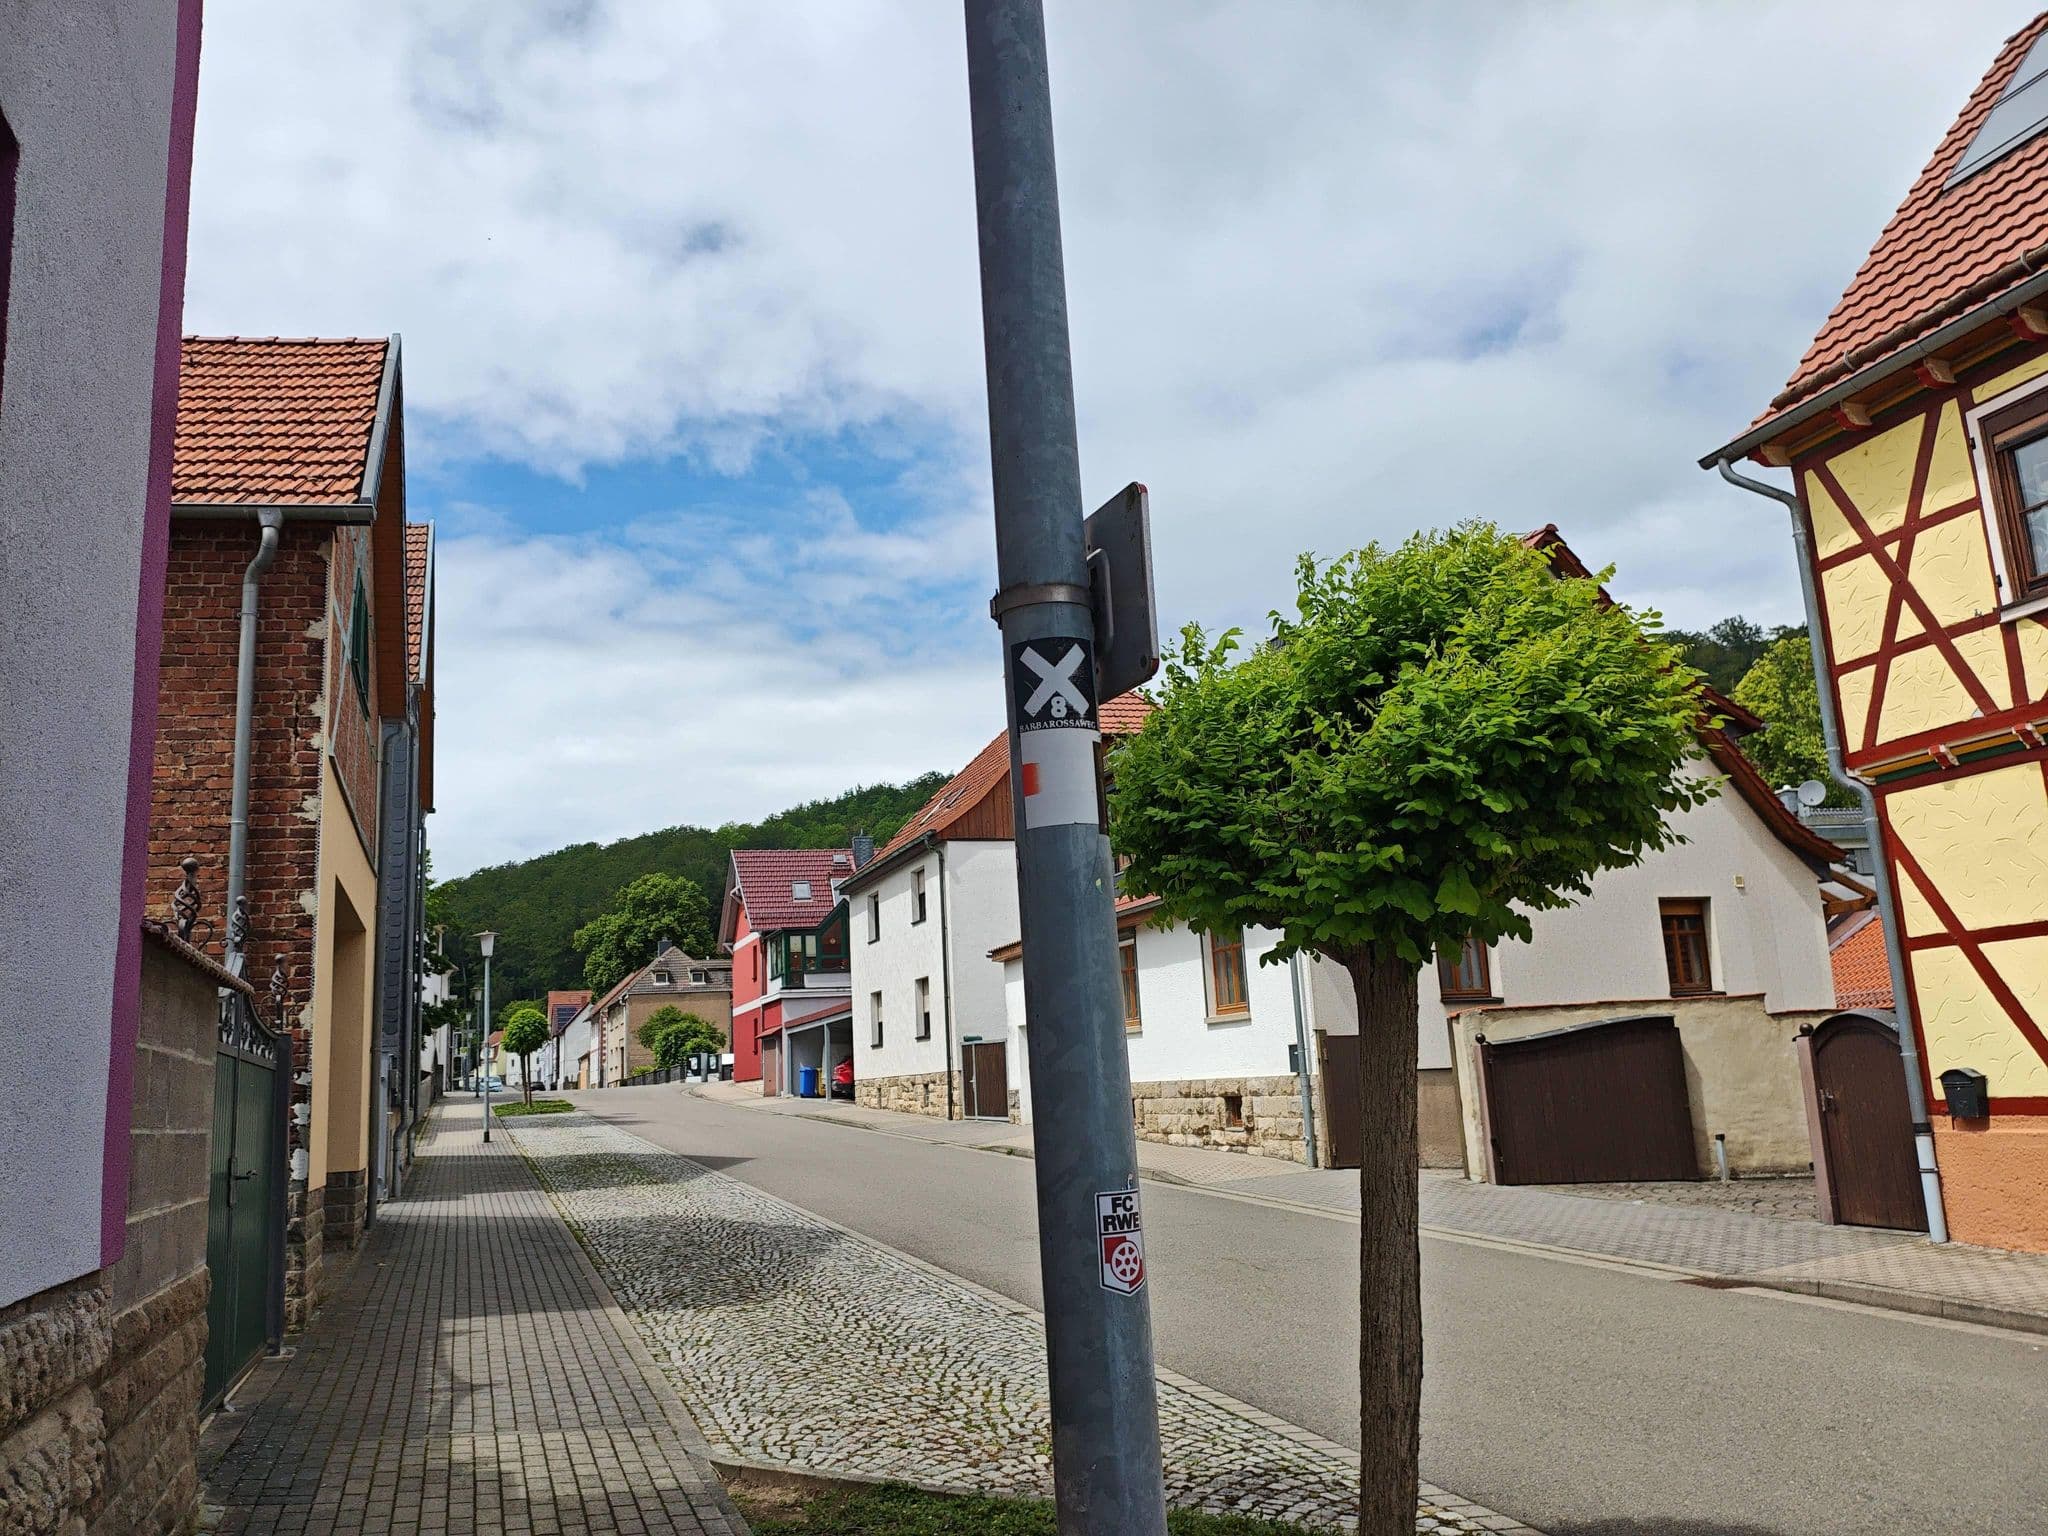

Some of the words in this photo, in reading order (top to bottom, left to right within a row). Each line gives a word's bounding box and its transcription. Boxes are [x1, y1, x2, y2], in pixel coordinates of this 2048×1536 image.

[1051, 696, 1067, 718] 8
[1019, 719, 1096, 733] BARBAROSSAWEG
[1111, 1196, 1133, 1213] FC
[1103, 1212, 1139, 1232] RWE
